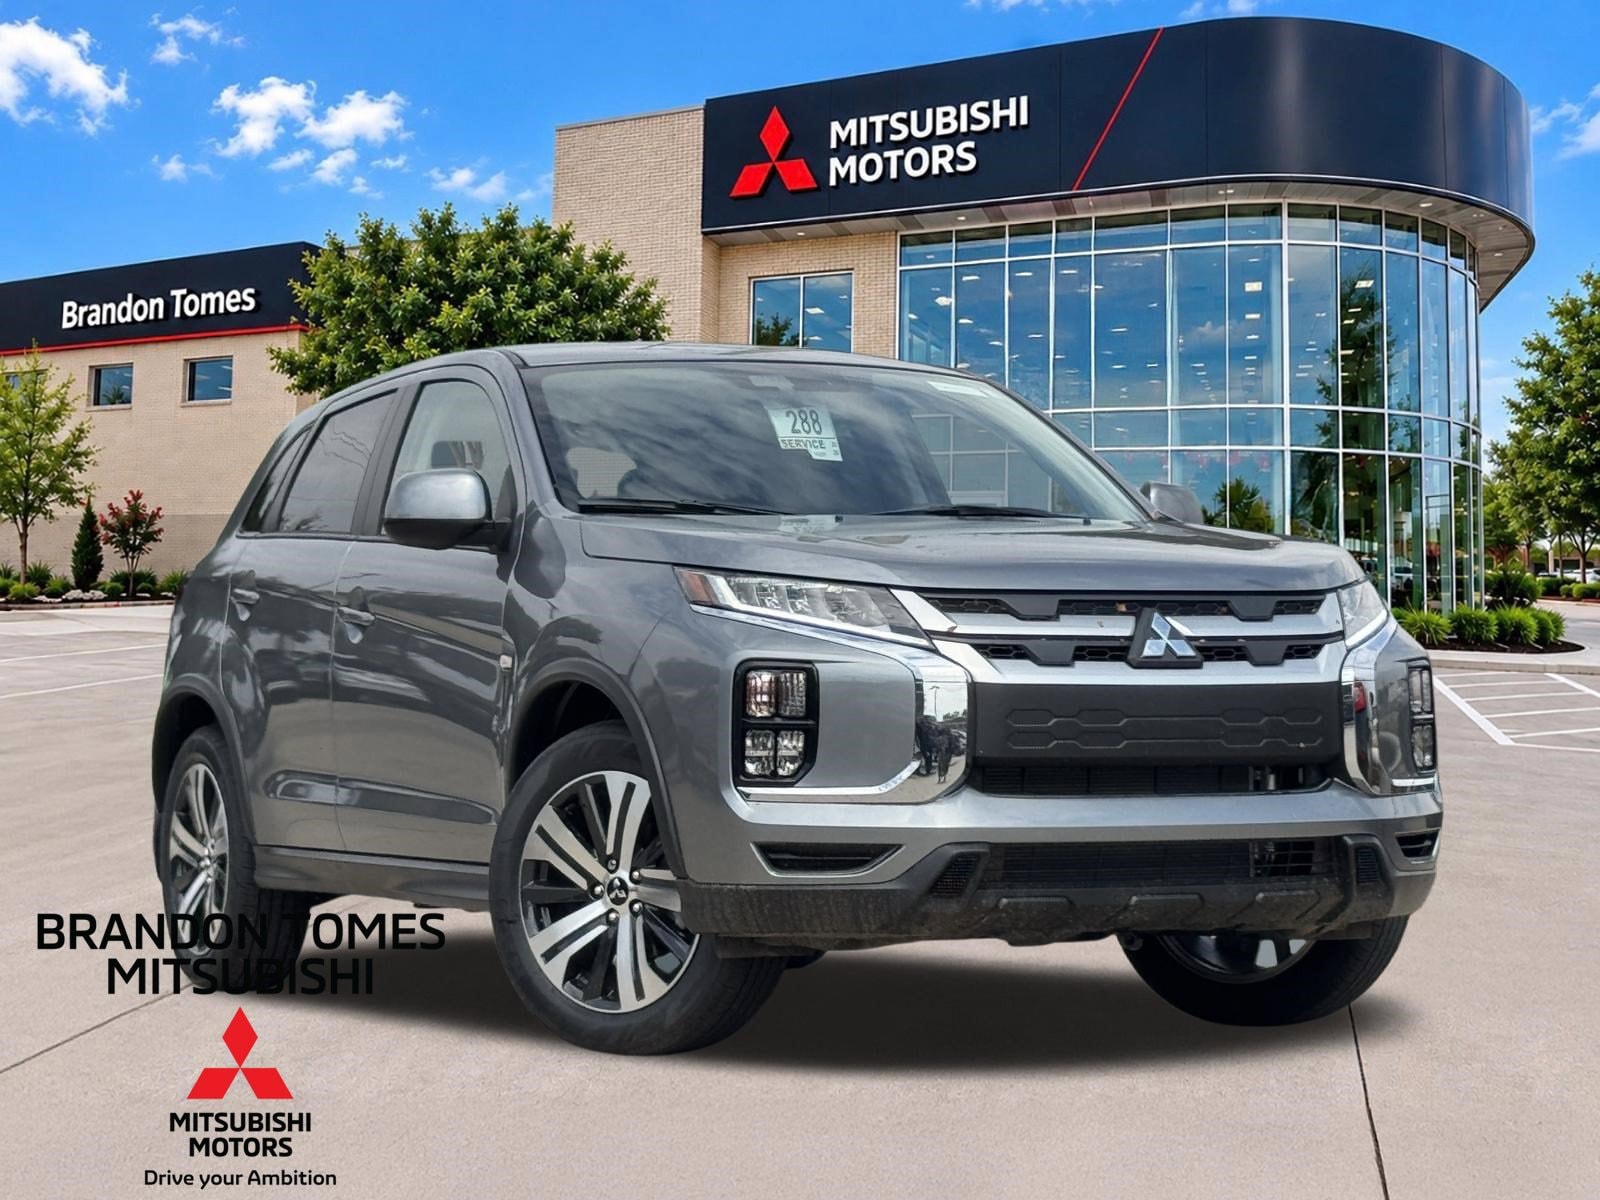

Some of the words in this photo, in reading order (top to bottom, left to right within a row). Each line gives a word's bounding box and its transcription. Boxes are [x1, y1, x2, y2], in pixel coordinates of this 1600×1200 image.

[829, 95, 1029, 149] MITSUBISHI
[829, 141, 977, 187] MOTORS
[61, 292, 164, 329] Brandon
[170, 287, 256, 318] Tomes
[785, 409, 822, 435] 288
[781, 439, 826, 449] SERVICE
